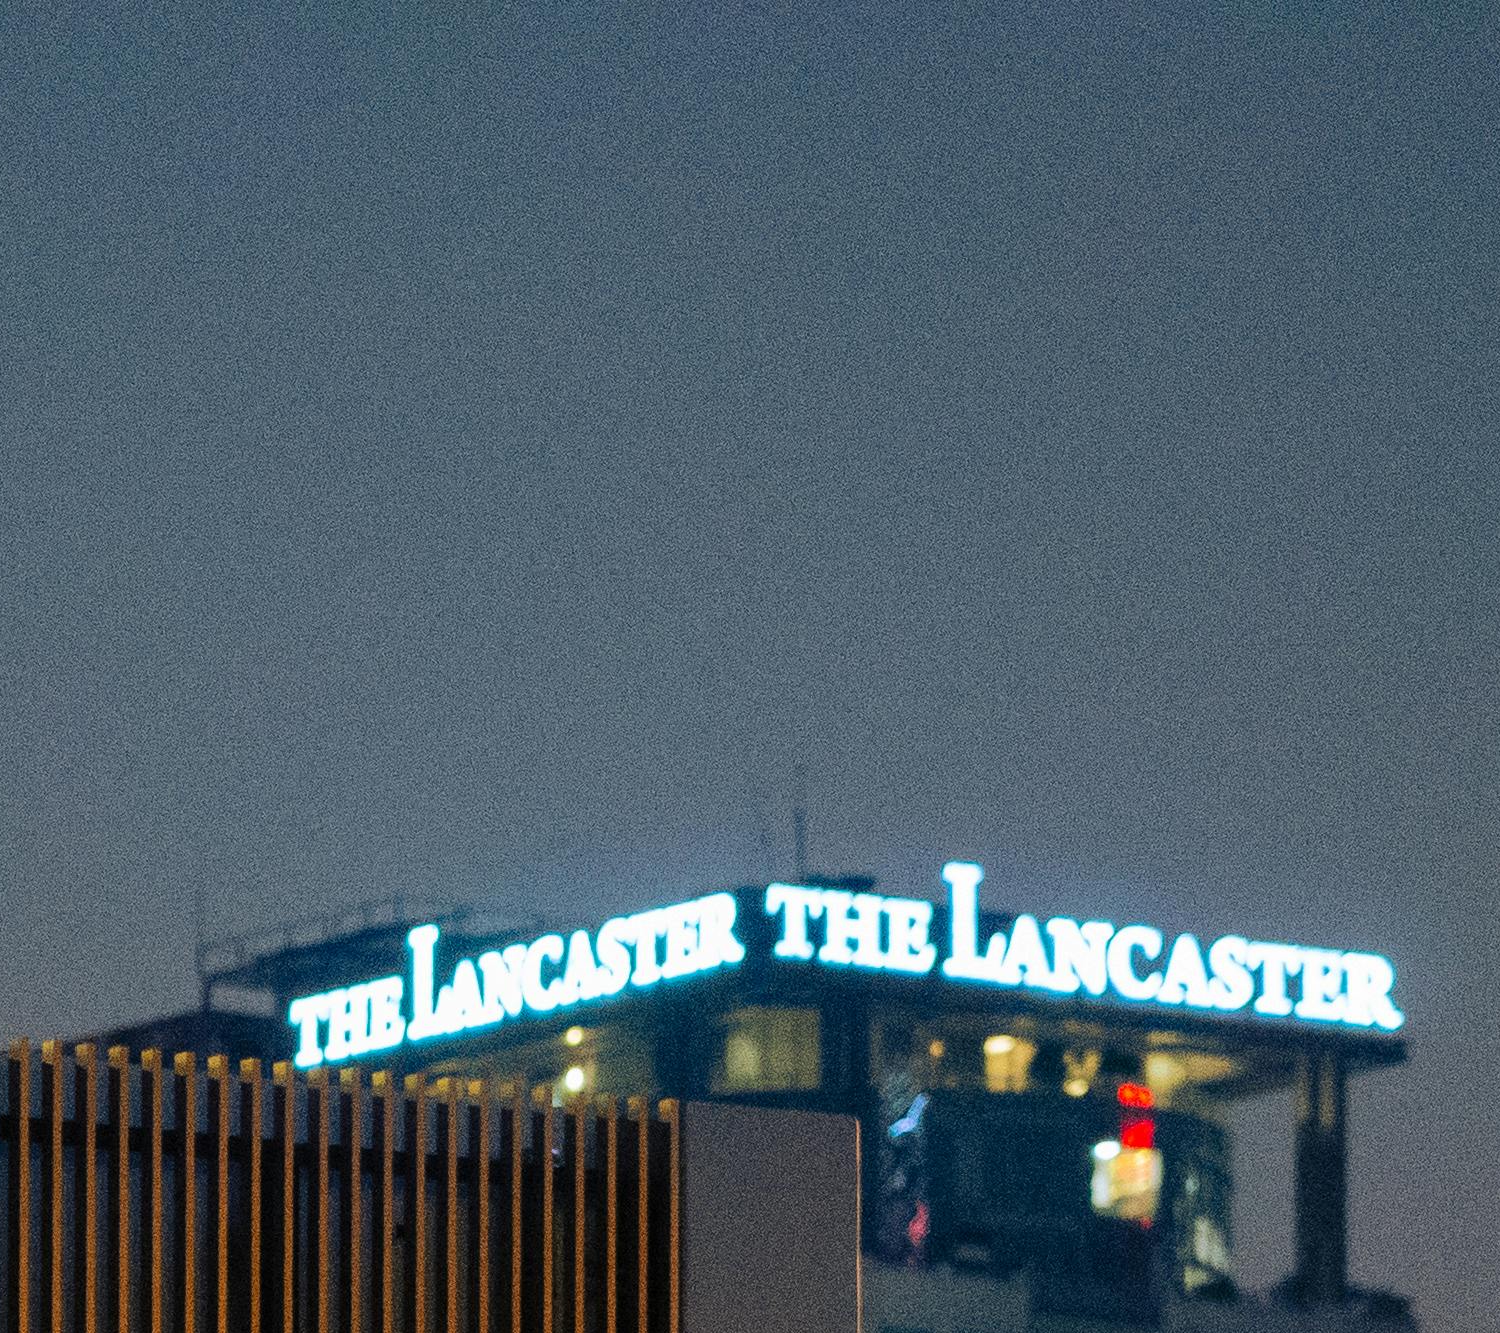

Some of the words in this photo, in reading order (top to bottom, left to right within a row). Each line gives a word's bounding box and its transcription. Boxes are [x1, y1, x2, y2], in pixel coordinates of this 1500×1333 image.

[289, 975, 406, 1067] THE
[406, 892, 746, 1042] LANCASTER
[765, 883, 936, 974] THE
[941, 861, 1404, 1031] LANCASTER
